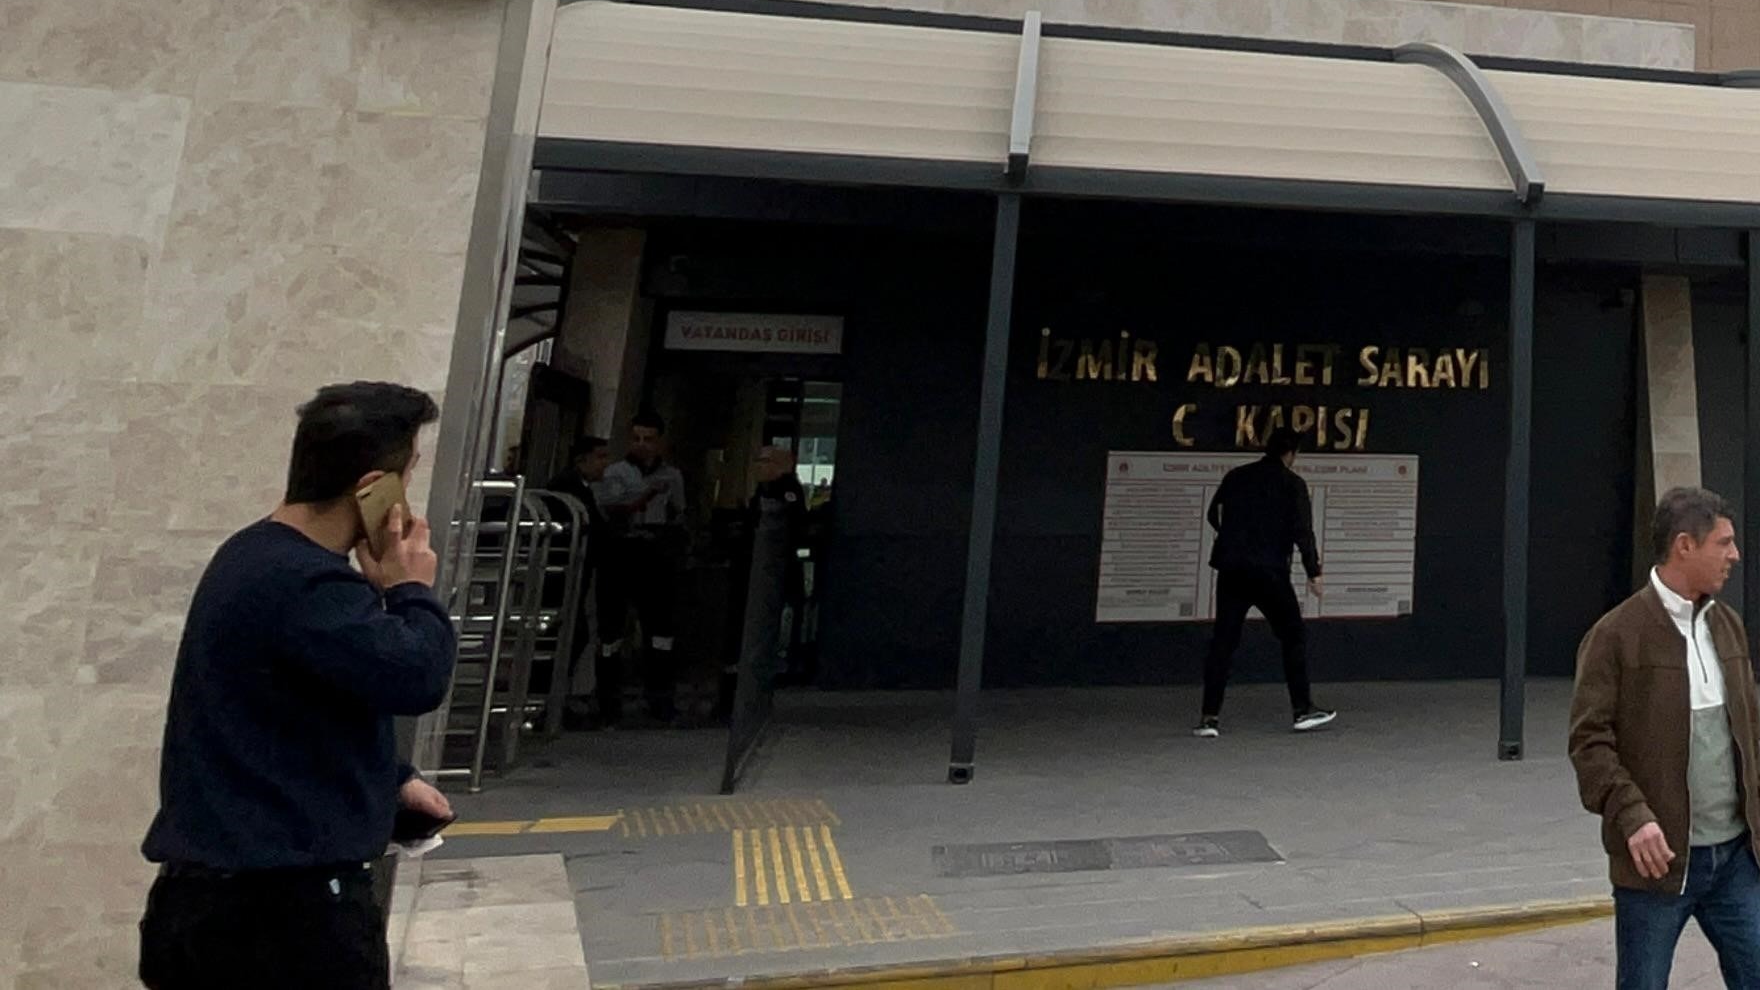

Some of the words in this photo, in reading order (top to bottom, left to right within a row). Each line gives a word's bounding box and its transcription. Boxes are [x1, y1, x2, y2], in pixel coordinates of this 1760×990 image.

[681, 324, 772, 342] VATANDAŞ
[777, 327, 830, 344] GİRİŞİ
[1036, 327, 1158, 382] İZMİR
[1187, 342, 1334, 387] ADALET
[1357, 345, 1489, 390] SARAYI
[1172, 404, 1198, 446] C
[1235, 404, 1371, 450] KAPISI
